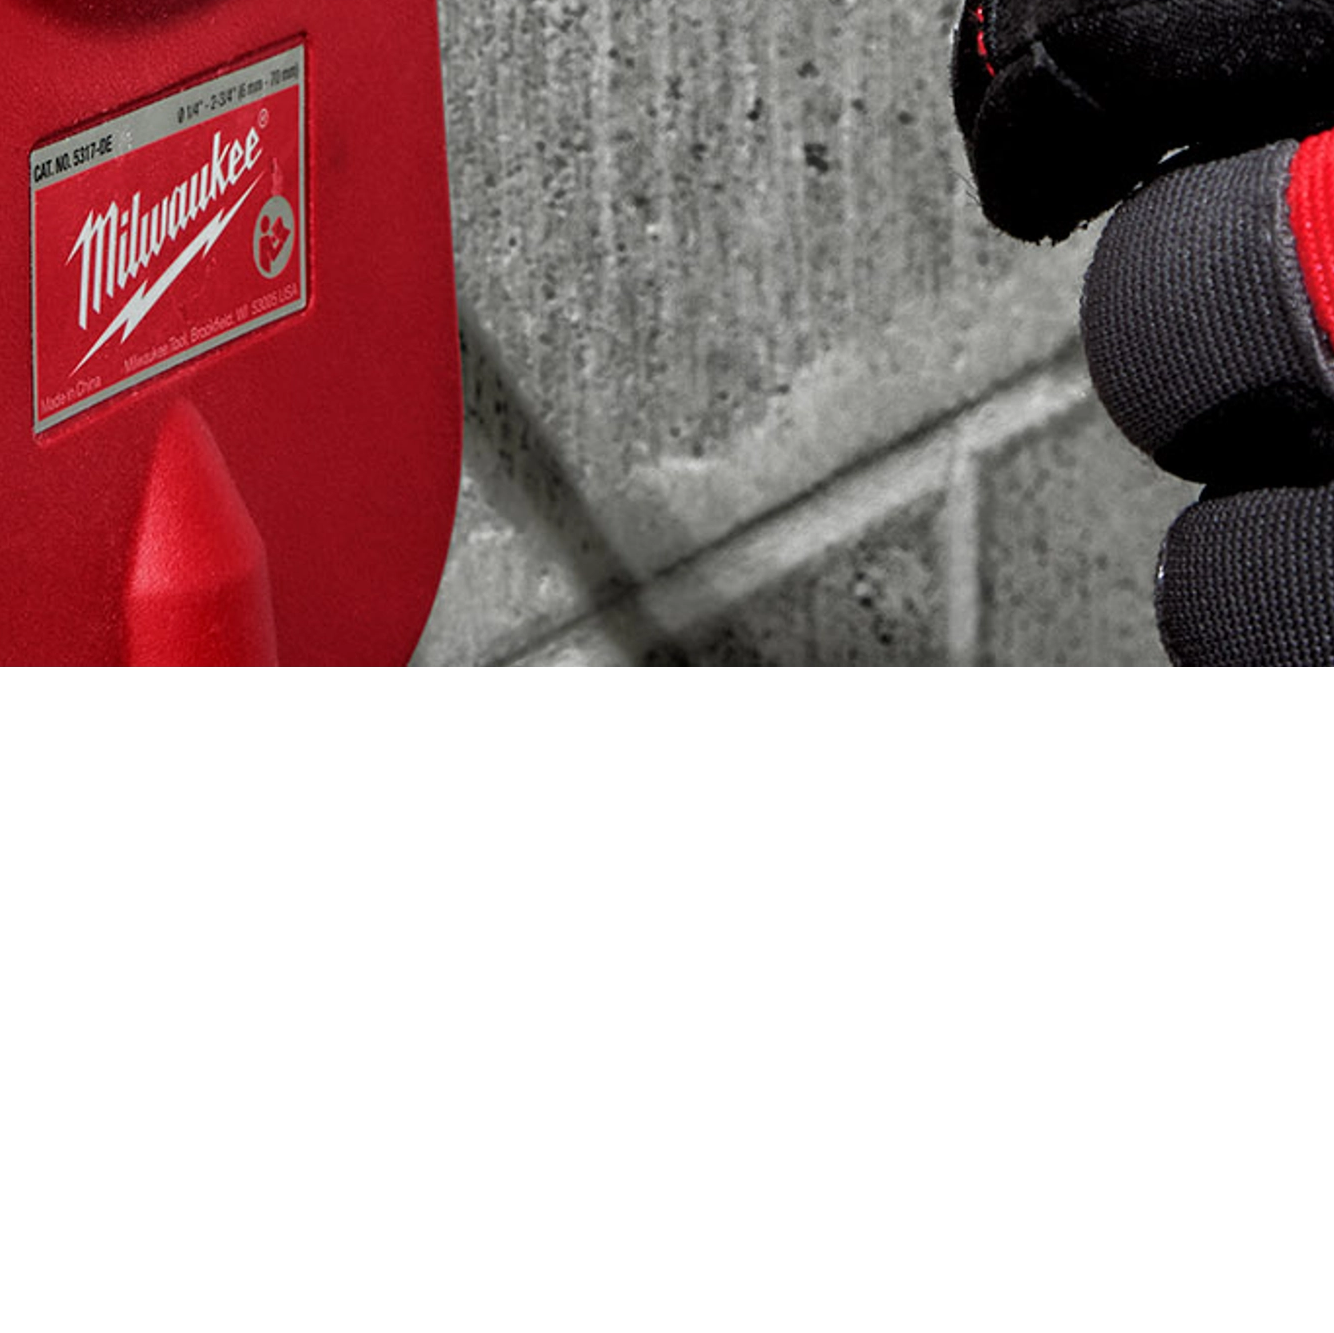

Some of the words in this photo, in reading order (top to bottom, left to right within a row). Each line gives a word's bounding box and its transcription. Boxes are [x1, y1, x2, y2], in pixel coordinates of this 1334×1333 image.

[33, 149, 54, 183] CAT.
[55, 152, 72, 174] NO.
[73, 133, 113, 167] 5317-DE
